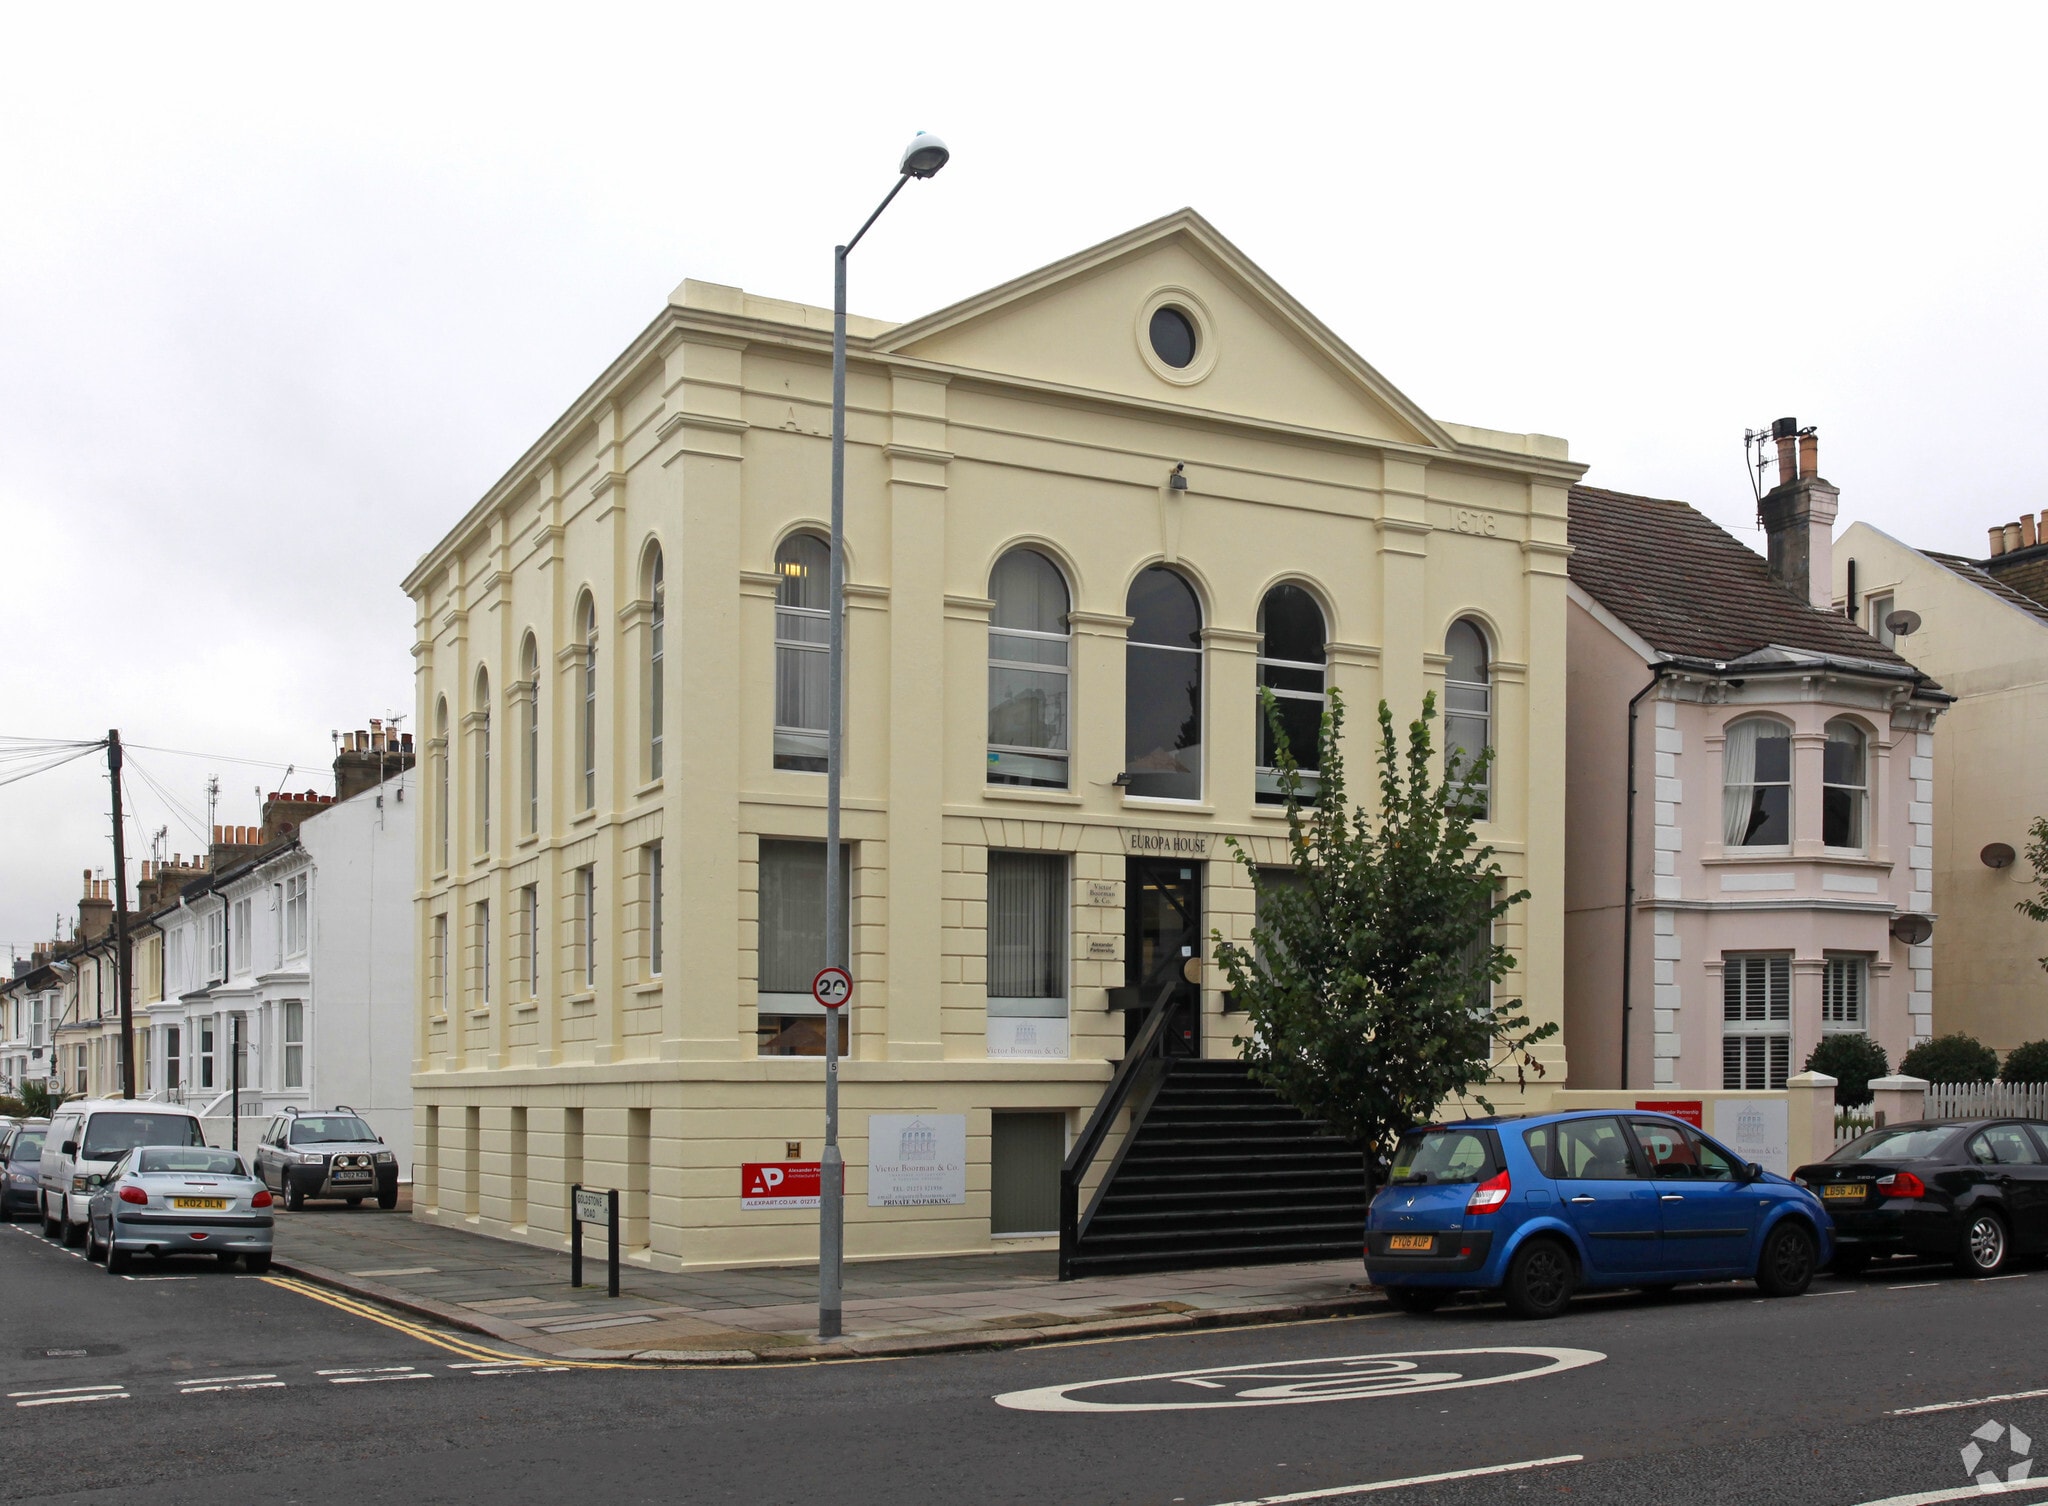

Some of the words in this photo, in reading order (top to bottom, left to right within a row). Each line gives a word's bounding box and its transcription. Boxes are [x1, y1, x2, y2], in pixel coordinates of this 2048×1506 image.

[1449, 508, 1497, 537] 1878
[1131, 834, 1170, 851] EUROPA
[1173, 837, 1206, 853] HOUSE
[819, 979, 846, 996] 20
[831, 1063, 837, 1071] 5
[787, 1142, 800, 1158] H
[875, 1164, 899, 1172] Victor
[901, 1164, 935, 1172] Boorman
[946, 1163, 960, 1171] Co.
[751, 1167, 784, 1194] AP
[177, 1199, 203, 1208] LK02
[204, 1199, 223, 1209] DLN
[584, 1207, 596, 1218] ROAD
[1412, 1236, 1429, 1247] AUP
